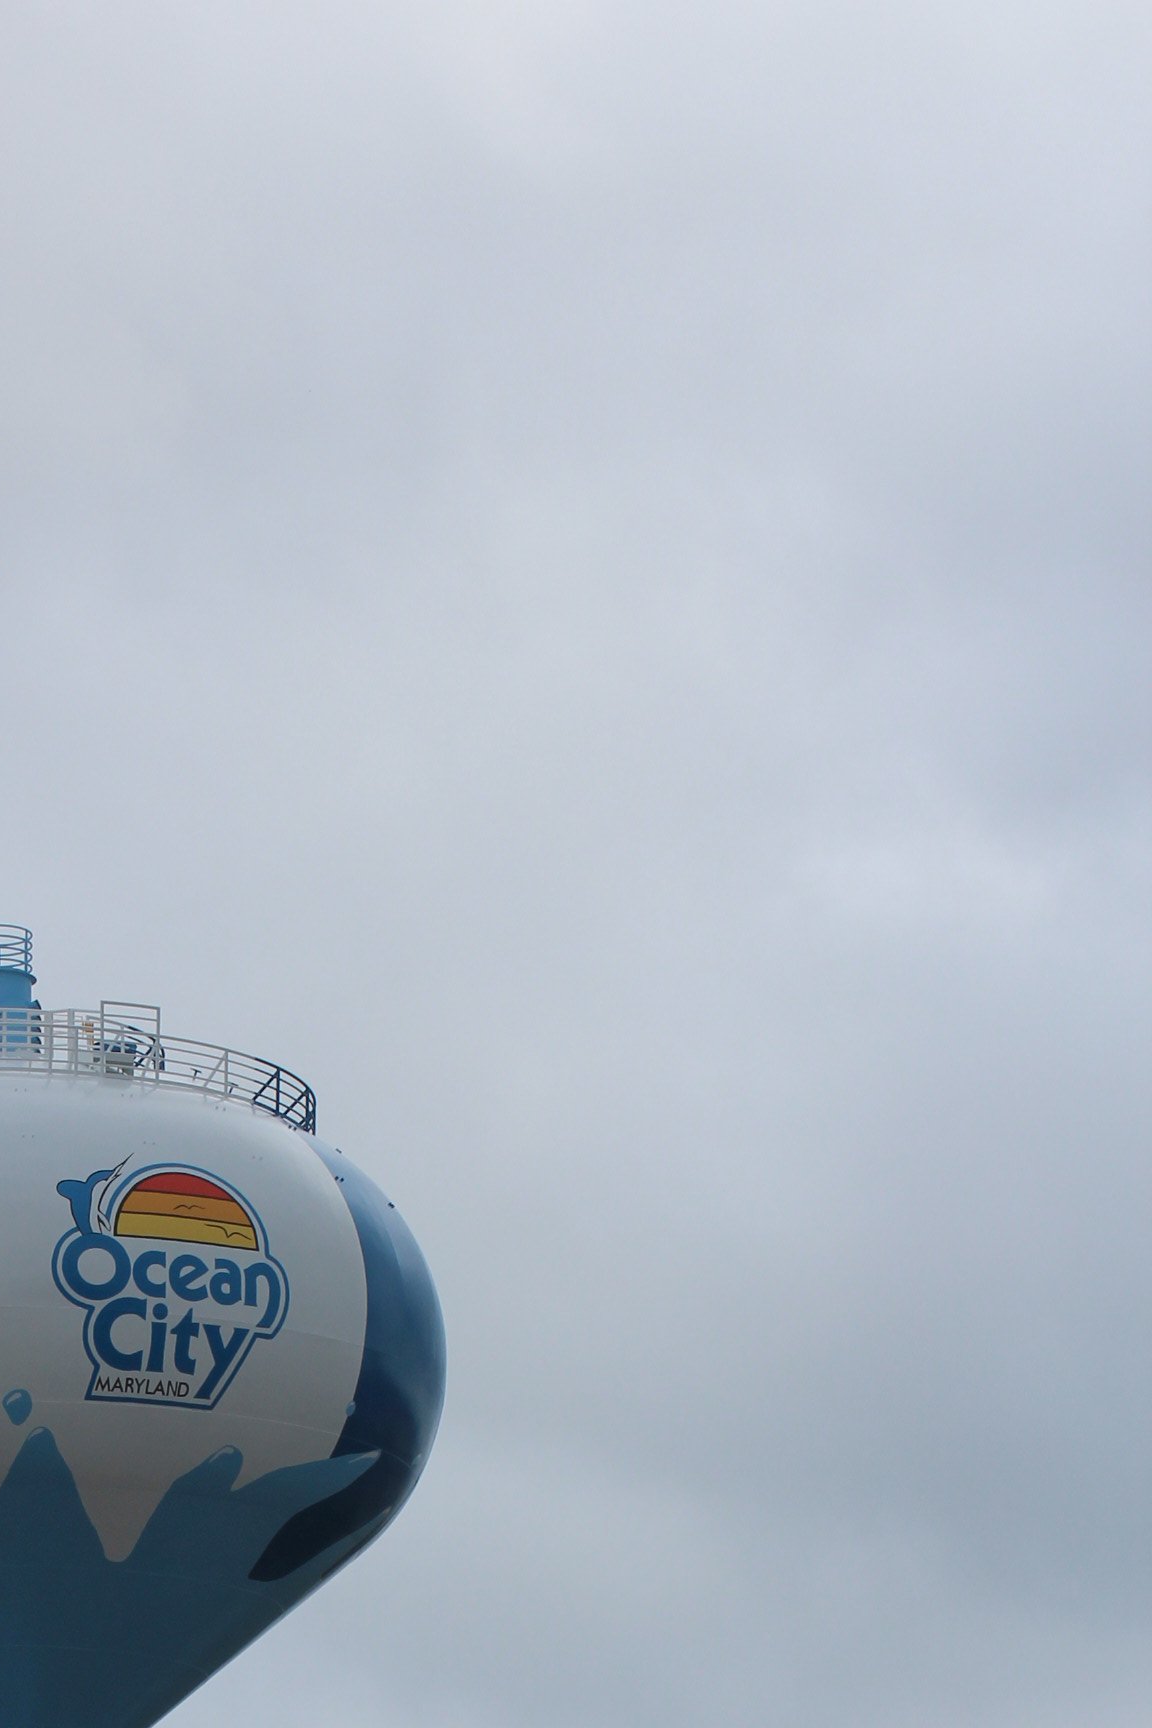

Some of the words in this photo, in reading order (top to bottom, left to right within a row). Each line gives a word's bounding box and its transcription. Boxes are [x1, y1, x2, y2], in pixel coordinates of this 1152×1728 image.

[62, 1232, 281, 1328] Ocean
[93, 1297, 251, 1400] City
[94, 1376, 190, 1398] MARYLAND
